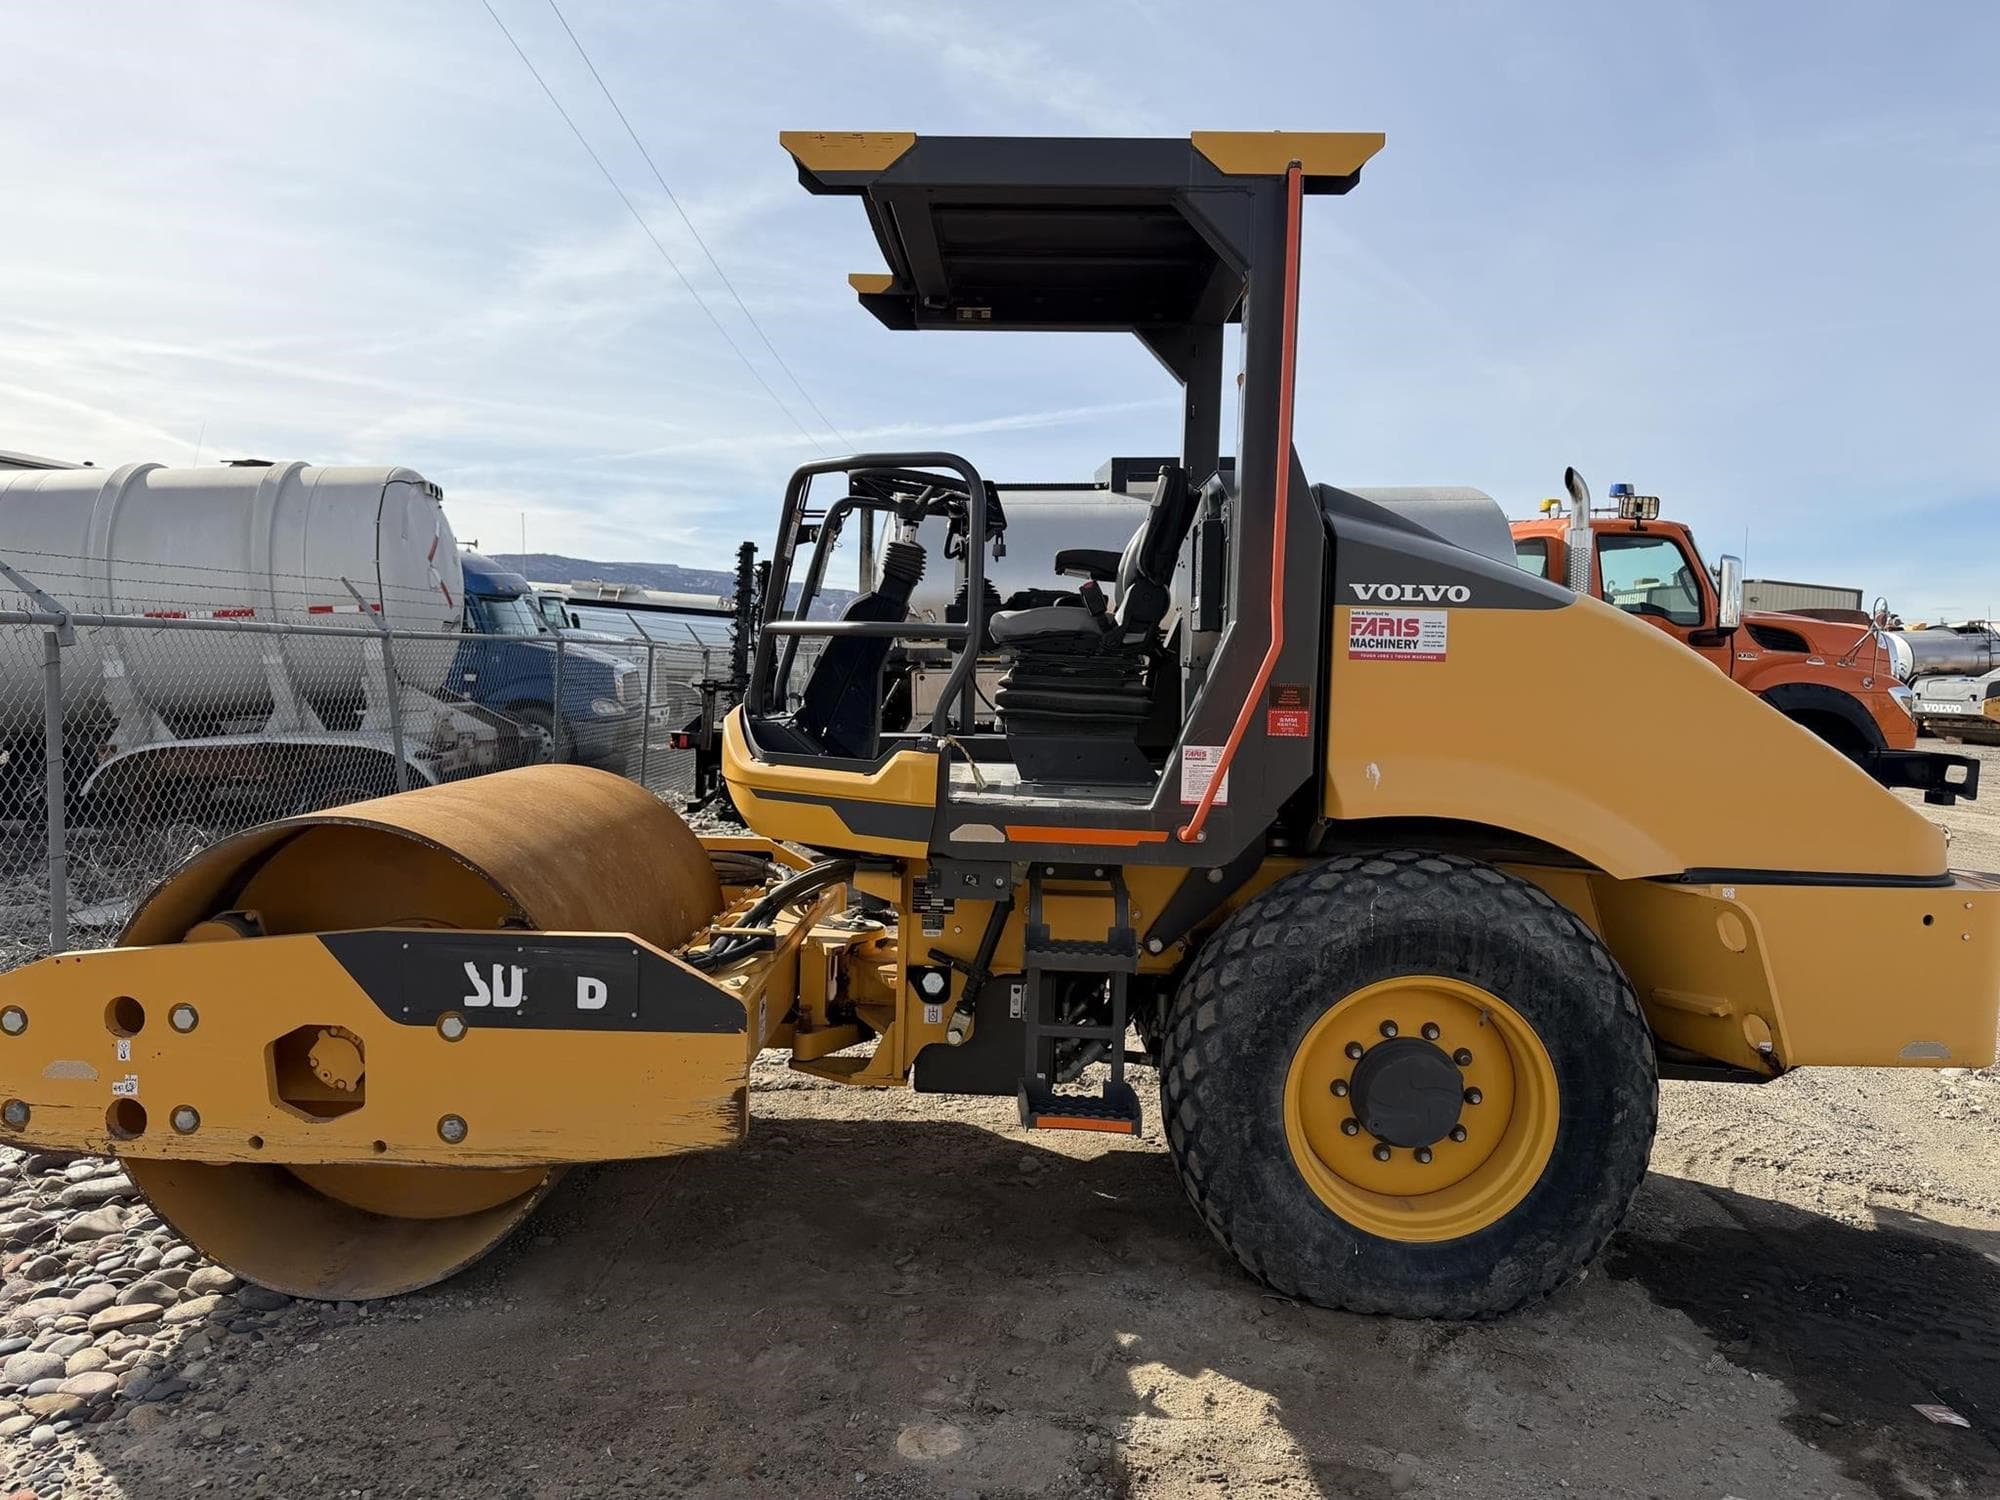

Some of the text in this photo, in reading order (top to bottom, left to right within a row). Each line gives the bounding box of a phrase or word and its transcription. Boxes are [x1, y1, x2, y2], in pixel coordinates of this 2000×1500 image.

[1349, 583, 1471, 602] VOLVO
[1350, 617, 1420, 637] FARIS
[1350, 638, 1419, 649] MACHINERY
[1923, 703, 1961, 713] VOLVO
